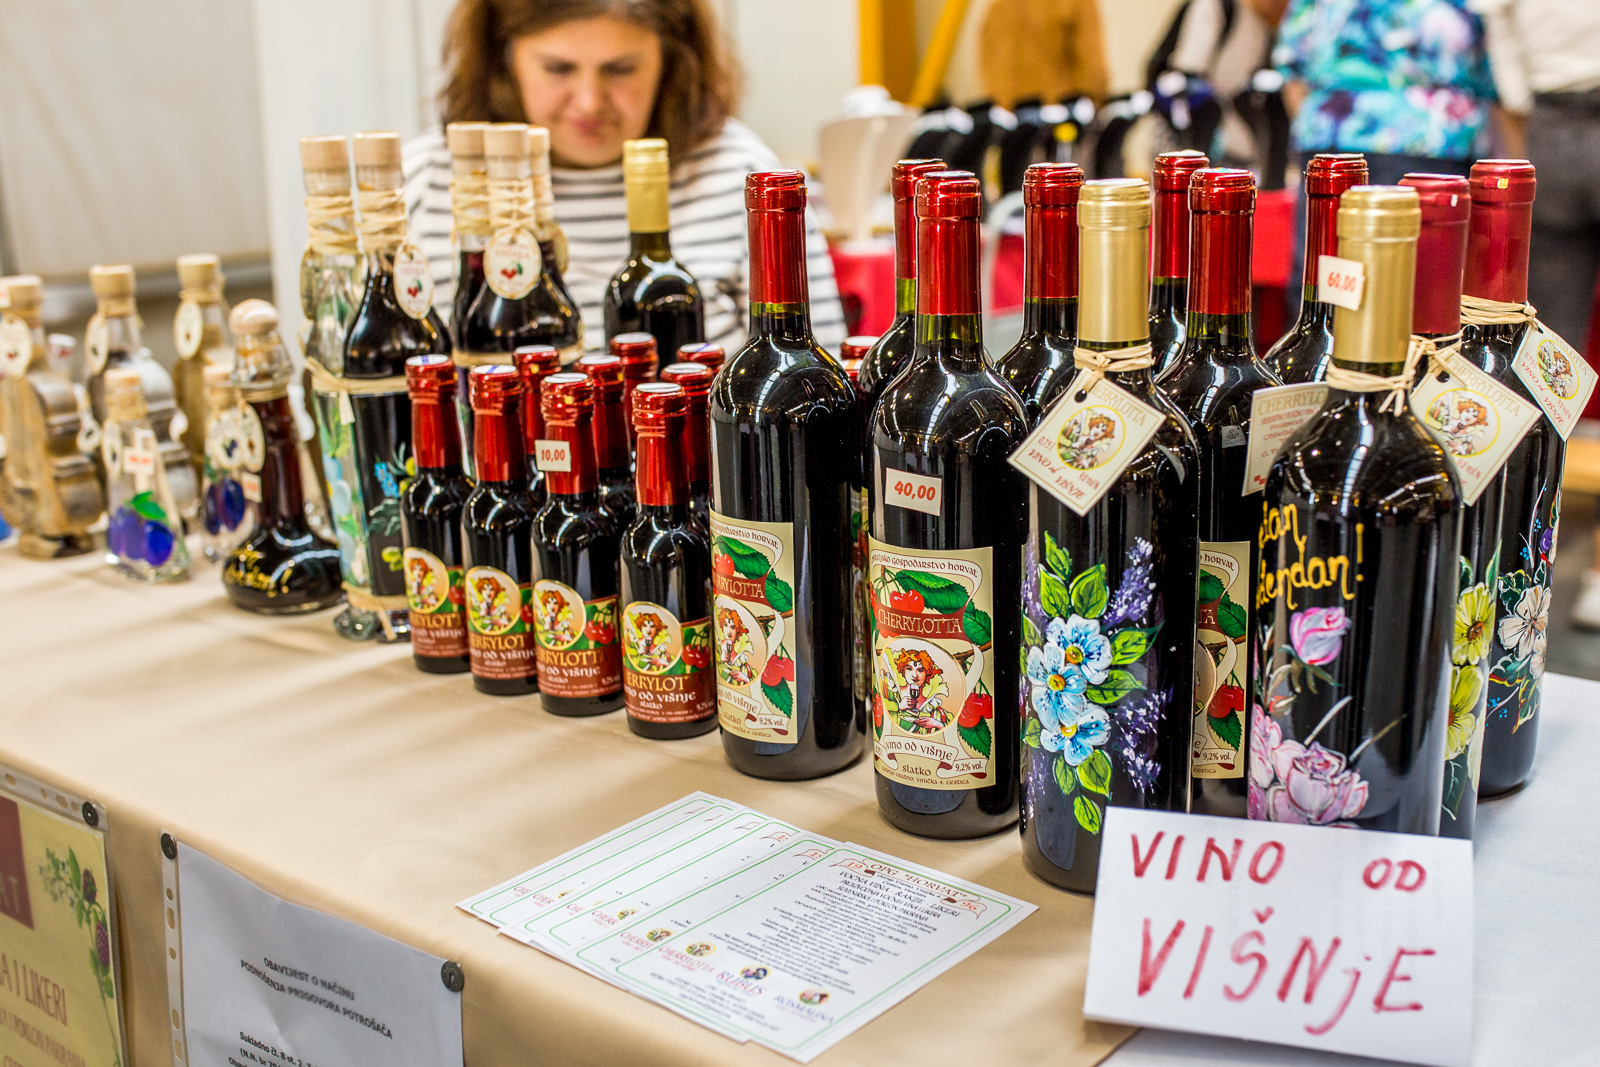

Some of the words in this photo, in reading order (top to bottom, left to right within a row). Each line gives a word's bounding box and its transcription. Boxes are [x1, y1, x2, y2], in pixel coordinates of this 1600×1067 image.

[542, 449, 566, 462] 10,00
[1028, 448, 1052, 467] VINO
[894, 480, 936, 501] 40,00
[878, 608, 962, 634] CHERRYLOTTA
[638, 691, 654, 701] od
[656, 692, 696, 704] višnje
[734, 696, 758, 714] višnje
[758, 717, 773, 726] 9,2%
[886, 741, 902, 750] vino
[904, 741, 917, 752] od
[920, 745, 952, 761] višnje
[1202, 752, 1218, 761] 9,2%
[902, 764, 932, 776] slatko
[955, 763, 971, 772] 9,2%
[847, 861, 863, 870] 19
[1131, 831, 1285, 884] VINO
[1362, 858, 1426, 892] OD
[870, 863, 899, 876] OPG
[905, 873, 968, 898] "HORVAT"
[960, 901, 980, 910] 96
[264, 957, 309, 983] OBAVIJEST
[311, 976, 319, 986] O
[320, 978, 356, 1002] NAČINU
[22, 965, 68, 1027] LIKERI
[240, 959, 286, 994] PODNOŠENJA
[342, 1006, 392, 1040] POTROŠAČA
[240, 1031, 270, 1053] Sukladno
